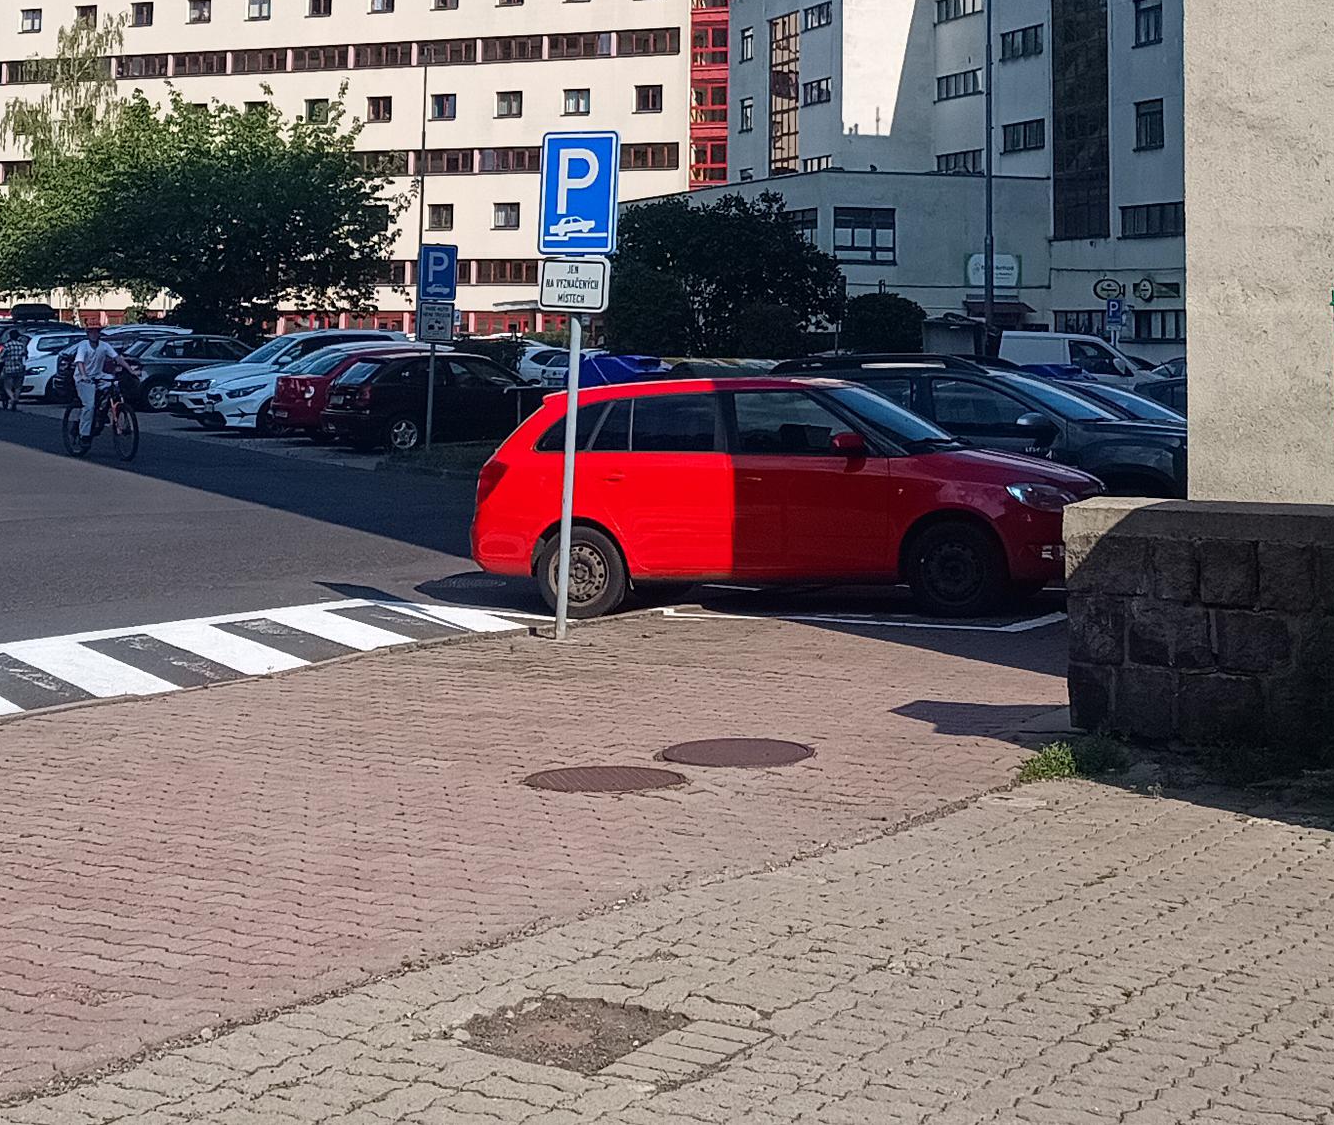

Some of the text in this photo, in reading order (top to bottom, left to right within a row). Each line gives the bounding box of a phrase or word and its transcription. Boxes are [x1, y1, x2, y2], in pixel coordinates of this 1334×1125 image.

[557, 148, 599, 214] P
[428, 251, 449, 283] P
[567, 264, 579, 274] JEN
[546, 278, 554, 288] NA
[557, 291, 585, 304] MÍSTECH
[1109, 301, 1119, 316] P
